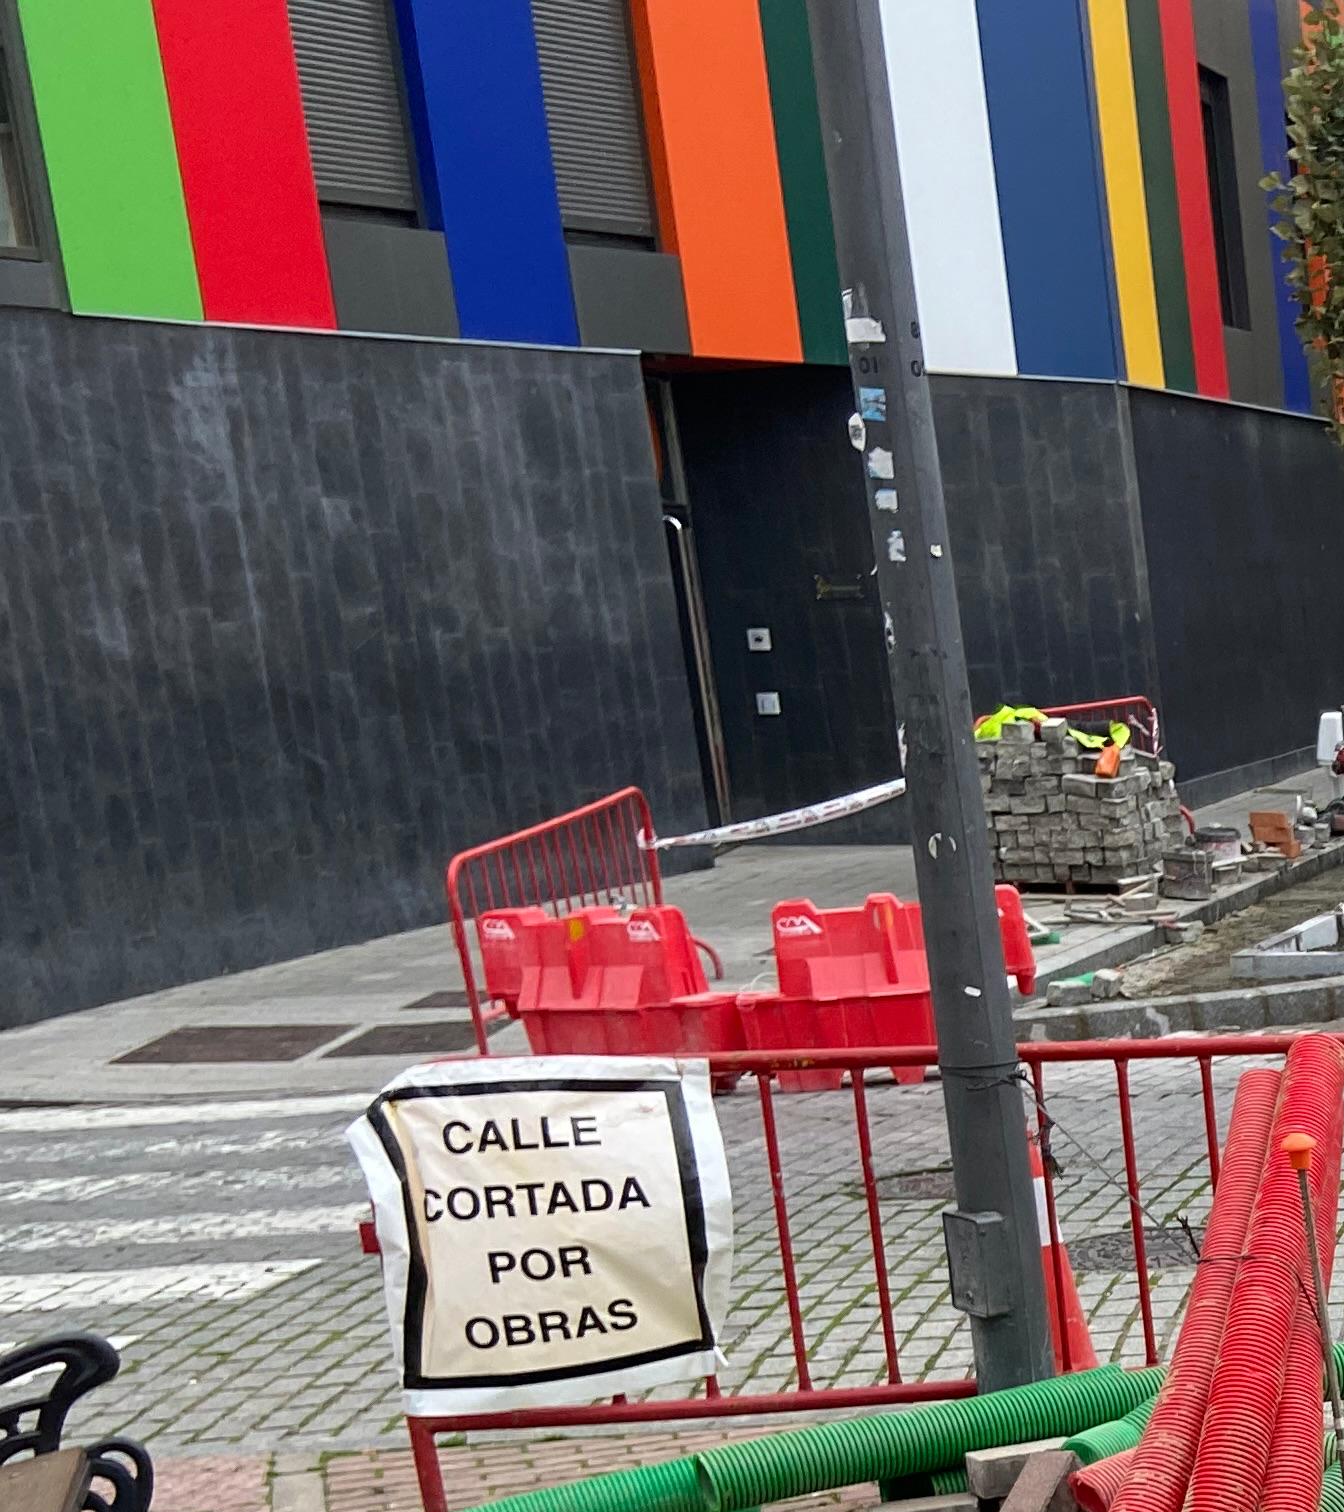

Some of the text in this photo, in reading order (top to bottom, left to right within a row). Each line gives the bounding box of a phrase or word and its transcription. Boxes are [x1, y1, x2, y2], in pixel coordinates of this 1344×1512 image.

[442, 1116, 602, 1154] CALLE
[424, 1176, 650, 1224] CORTADA
[487, 1246, 592, 1284] POR
[465, 1299, 639, 1350] OBRAS
